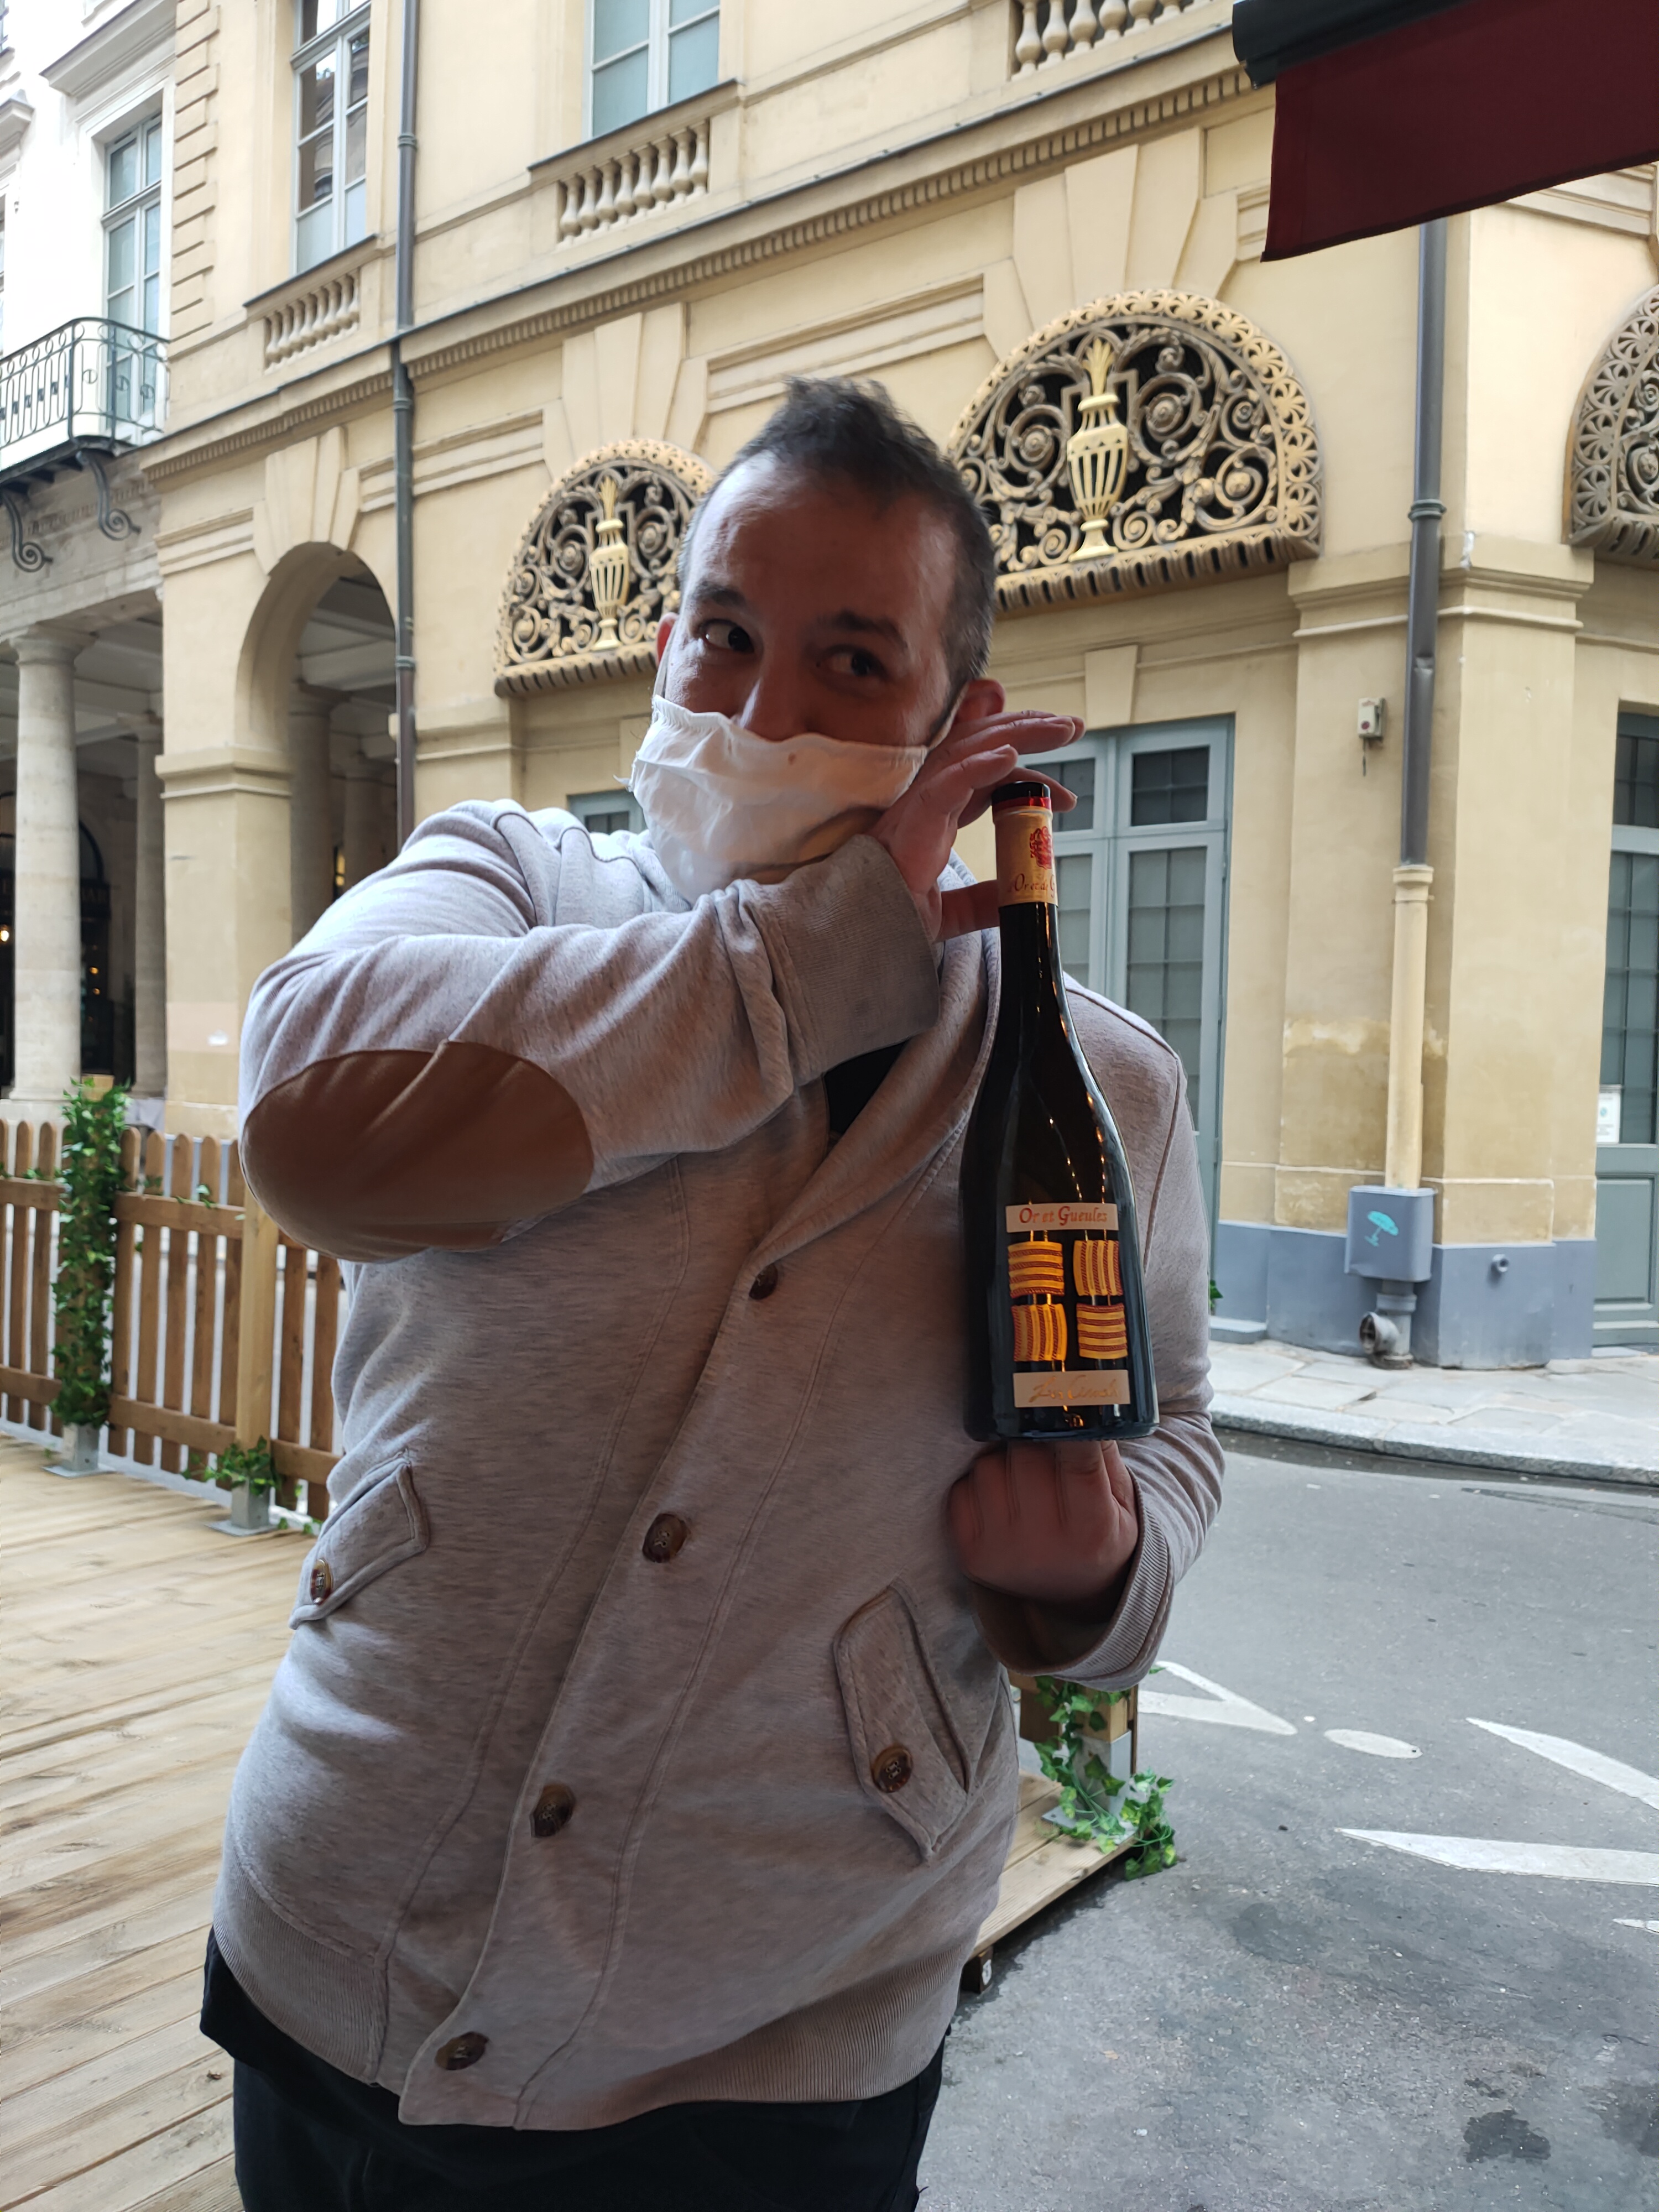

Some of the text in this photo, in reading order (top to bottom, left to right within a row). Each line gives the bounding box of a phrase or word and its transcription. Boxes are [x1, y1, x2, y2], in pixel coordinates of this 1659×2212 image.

[1019, 1206, 1108, 1226] Or et Gueules
